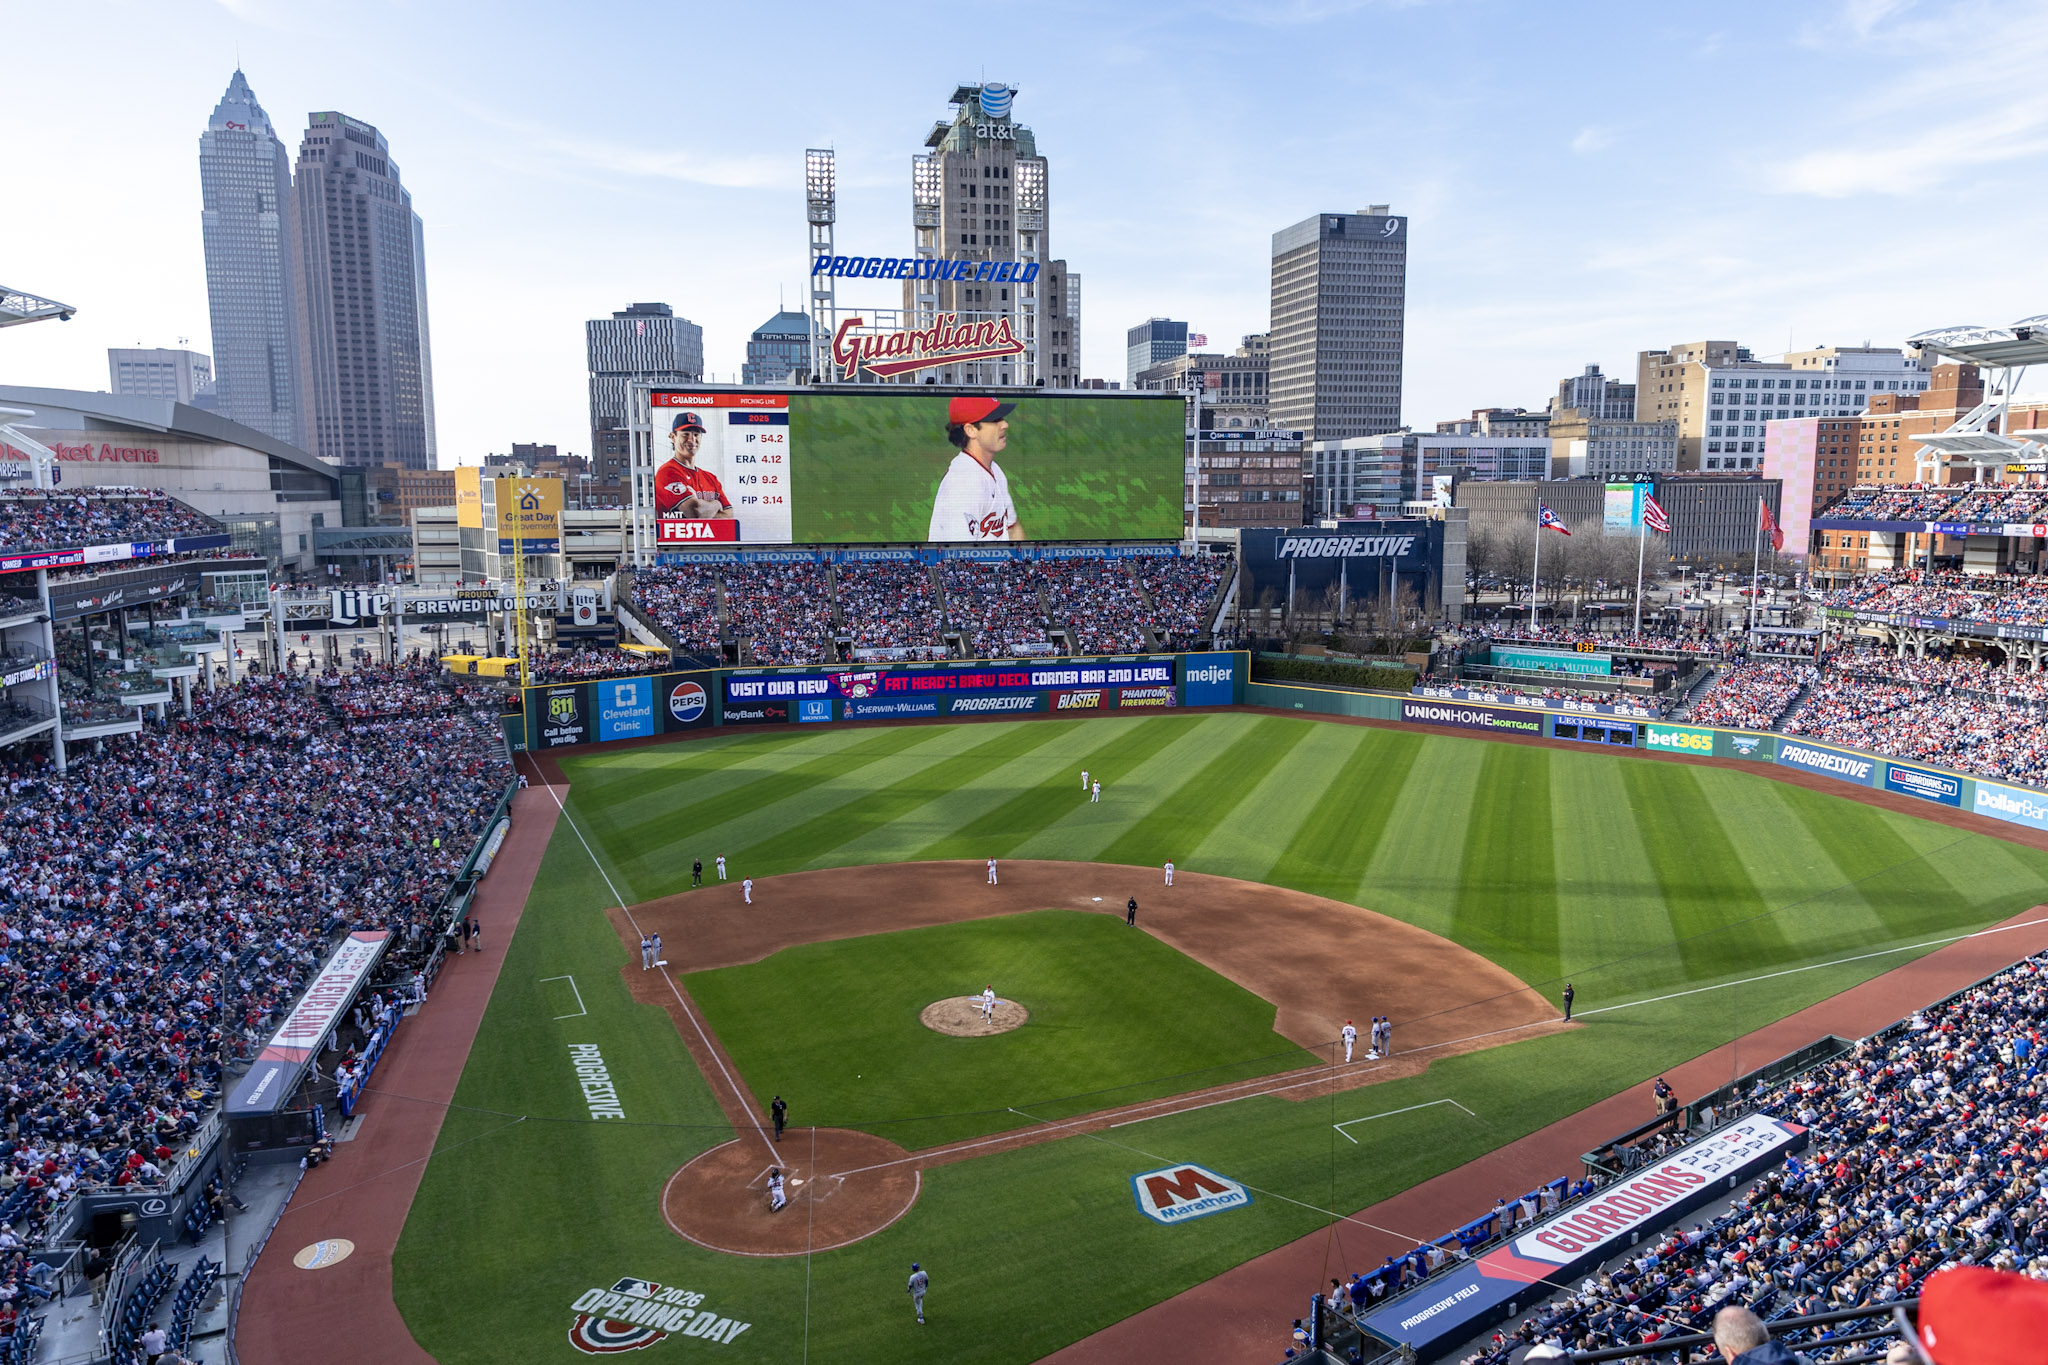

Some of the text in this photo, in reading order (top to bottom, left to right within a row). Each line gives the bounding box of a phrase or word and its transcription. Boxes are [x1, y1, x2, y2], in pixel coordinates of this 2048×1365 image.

[976, 121, 1017, 140] at&t
[1384, 218, 1399, 238] 9
[811, 255, 1041, 283] PROGRESSIVE FIELD
[832, 312, 1026, 379] Guardians
[671, 396, 714, 404] GUARDIANS
[746, 434, 783, 443] IP 54.2
[1255, 431, 1294, 440] RALLY HOUSE
[100, 443, 160, 463] Arena
[736, 455, 782, 463] ERA 4.12
[739, 475, 777, 484] K/9 9.2
[741, 496, 783, 504] FIP 3.14
[505, 513, 555, 523] Great Day
[662, 511, 683, 519] MATT
[663, 522, 715, 538] FESTA
[2035, 527, 2044, 535] 52
[1054, 548, 1107, 556] HONDA
[1123, 546, 1174, 556] HONDA
[1278, 537, 1416, 558] PROGRESSIVE
[679, 554, 738, 563] HONDA
[756, 553, 815, 562] HONDA
[858, 551, 914, 560] HONDA
[959, 550, 1013, 559] HONDA
[2, 559, 22, 569] CHANGEUP
[458, 591, 498, 599] PROUDLY
[575, 595, 595, 606] Lite
[329, 590, 391, 625] Lite
[417, 597, 538, 614] BREWED IN OHIO
[1857, 612, 1871, 622] CRAFT
[1577, 643, 1594, 652] 0:33
[1563, 663, 1605, 674] MUTUAL
[6, 672, 19, 686] CRAFT
[853, 672, 877, 682] HEAD'S
[884, 668, 1169, 690] FAT HEAD'S BREW DECK CORNER BAR 2ND LEVEL
[1187, 665, 1232, 685] meijer
[730, 680, 828, 696] VISIT OUR NEW
[1121, 689, 1167, 698] PHANTOM
[551, 698, 573, 715] 811
[672, 696, 704, 707] PEPSI
[951, 697, 1037, 711] PROGRESSIVE
[1057, 693, 1100, 709] BLASTER
[1120, 698, 1165, 706] FIREWORKS
[603, 705, 650, 720] Cleveland
[724, 710, 764, 720] KeyBank
[1405, 705, 1540, 731] UNIONHOME MORTGAGE
[544, 726, 583, 737] Call before
[614, 721, 640, 732] Clinic
[551, 735, 578, 746] you dig.
[1648, 729, 1712, 750] bet365
[1780, 745, 1872, 778] PROGRESSIVE
[280, 974, 356, 1038] CLEVELAND
[568, 1043, 626, 1120] PROGRESSIVE
[246, 1091, 262, 1105] FIELD
[1144, 1168, 1231, 1209] M
[1160, 1192, 1242, 1219] Marathon
[1536, 1166, 1707, 1254] GUARDIANS
[653, 1286, 705, 1307] 2026
[1400, 1283, 1480, 1331] PROGRESSIVE FIELD
[570, 1288, 752, 1345] OPENING DAY
